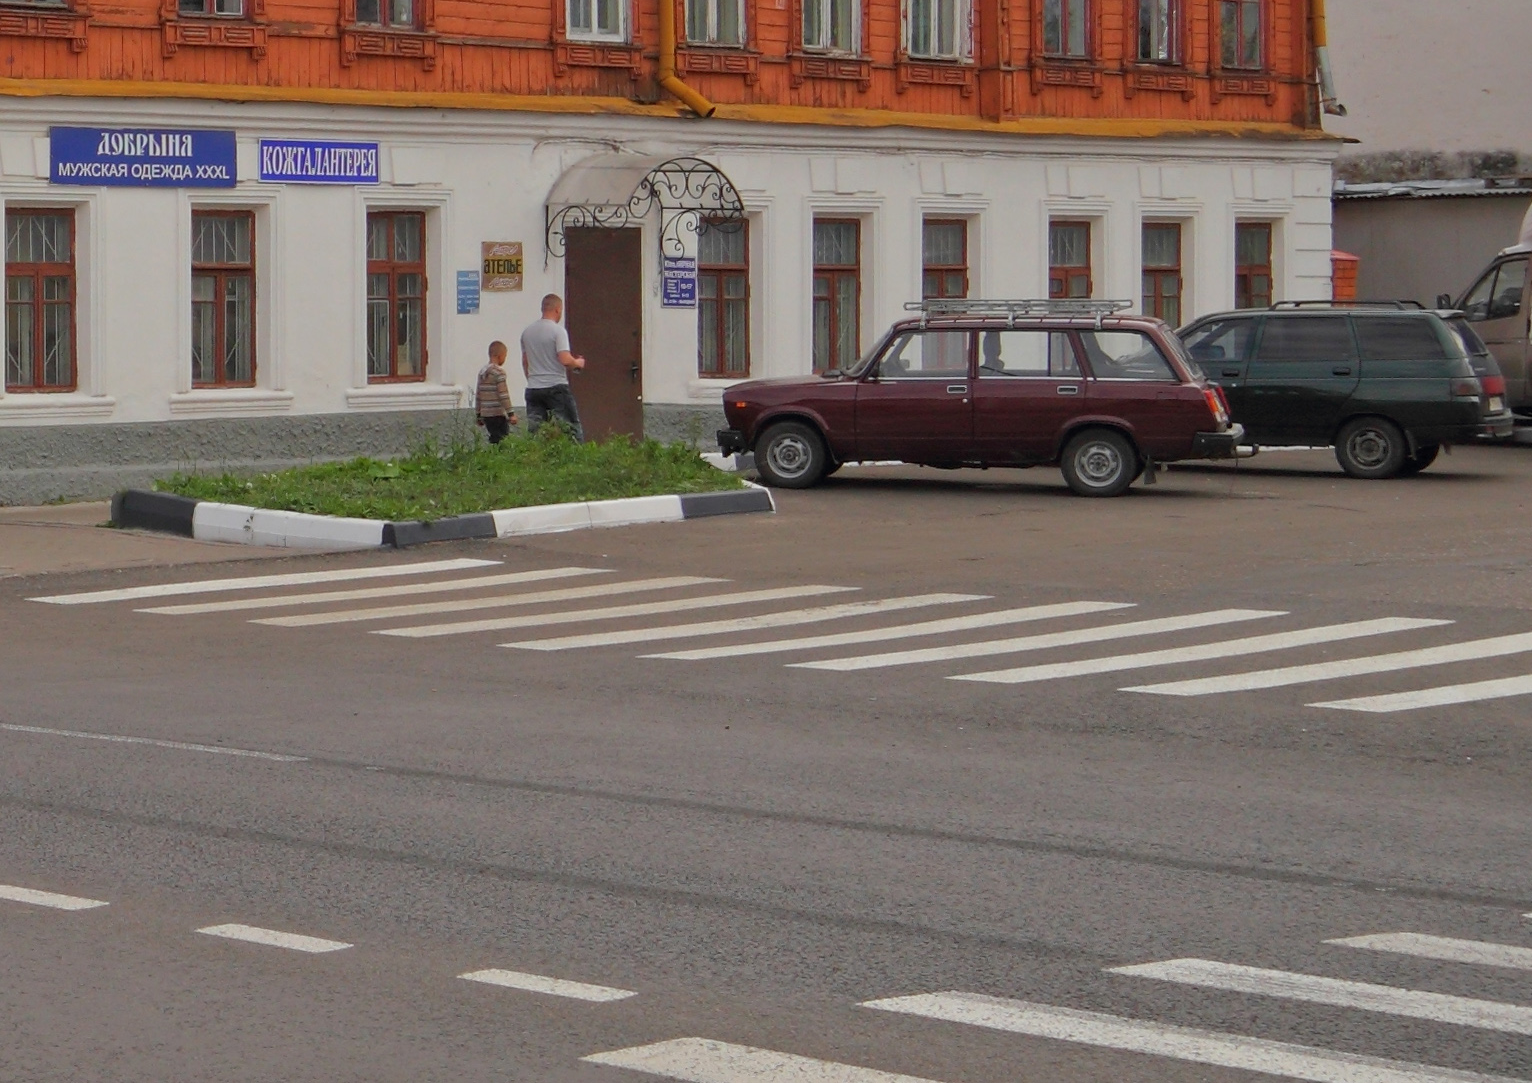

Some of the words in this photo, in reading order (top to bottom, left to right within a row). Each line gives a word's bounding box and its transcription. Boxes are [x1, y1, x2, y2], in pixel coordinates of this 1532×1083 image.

[97, 131, 193, 157] ДОБРЫНЯ
[58, 161, 128, 178] МУЖСКАЯ
[131, 163, 193, 181] ОДЕЖДА
[196, 165, 230, 180] XXXL
[262, 145, 377, 177] КОЖГАЛАНТЕРЕЯ
